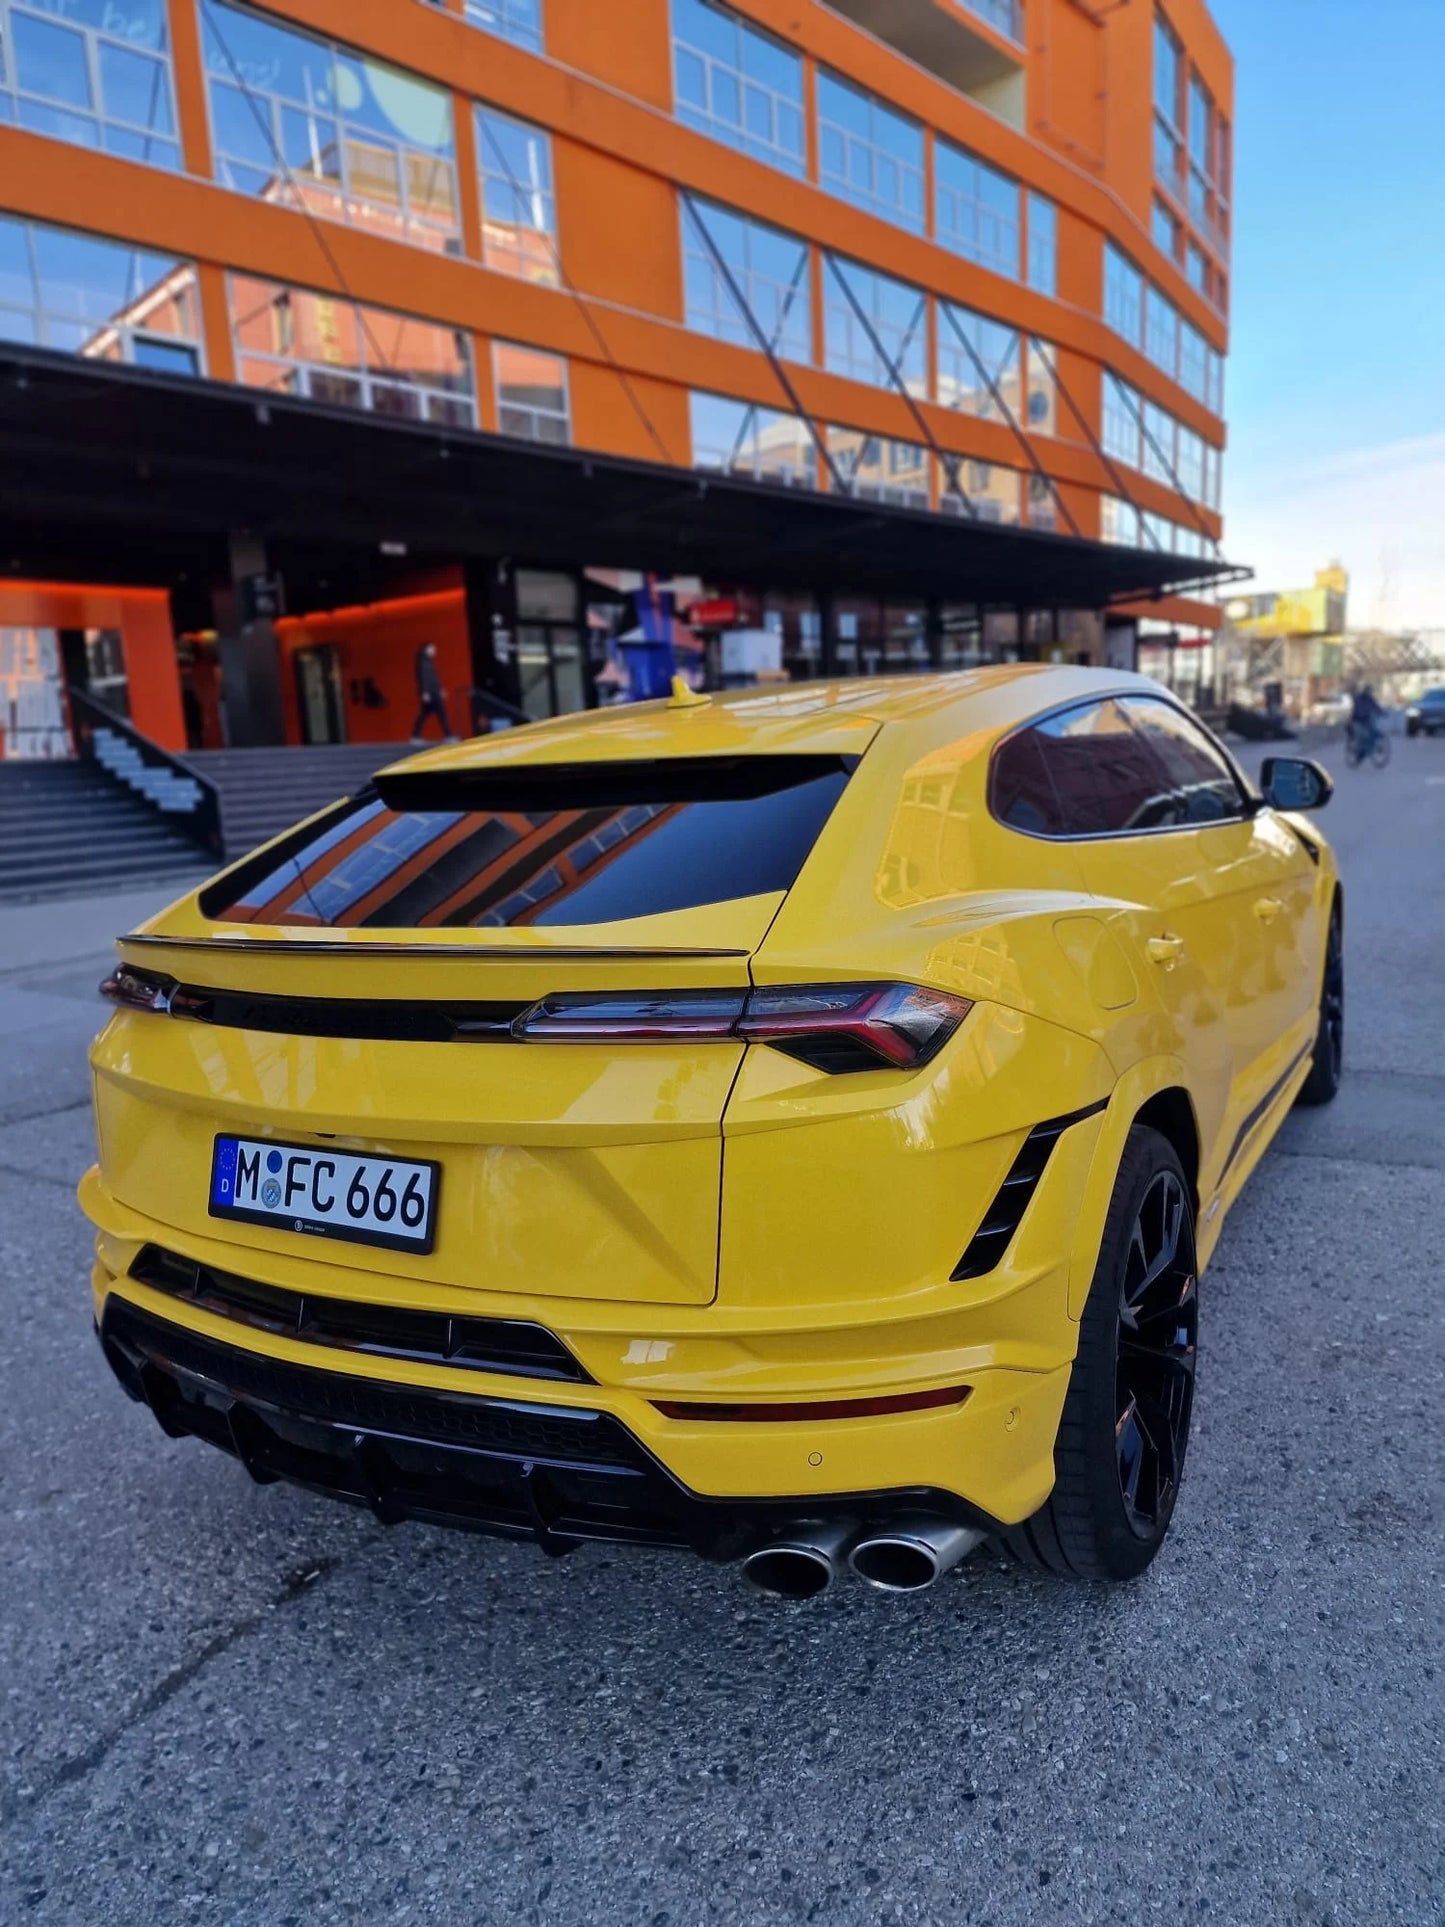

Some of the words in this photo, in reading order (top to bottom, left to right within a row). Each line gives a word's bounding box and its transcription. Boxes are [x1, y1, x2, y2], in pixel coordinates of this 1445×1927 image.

[221, 1178, 229, 1193] D
[235, 1148, 261, 1200] M
[284, 1156, 336, 1213] FC
[346, 1166, 425, 1227] 666
